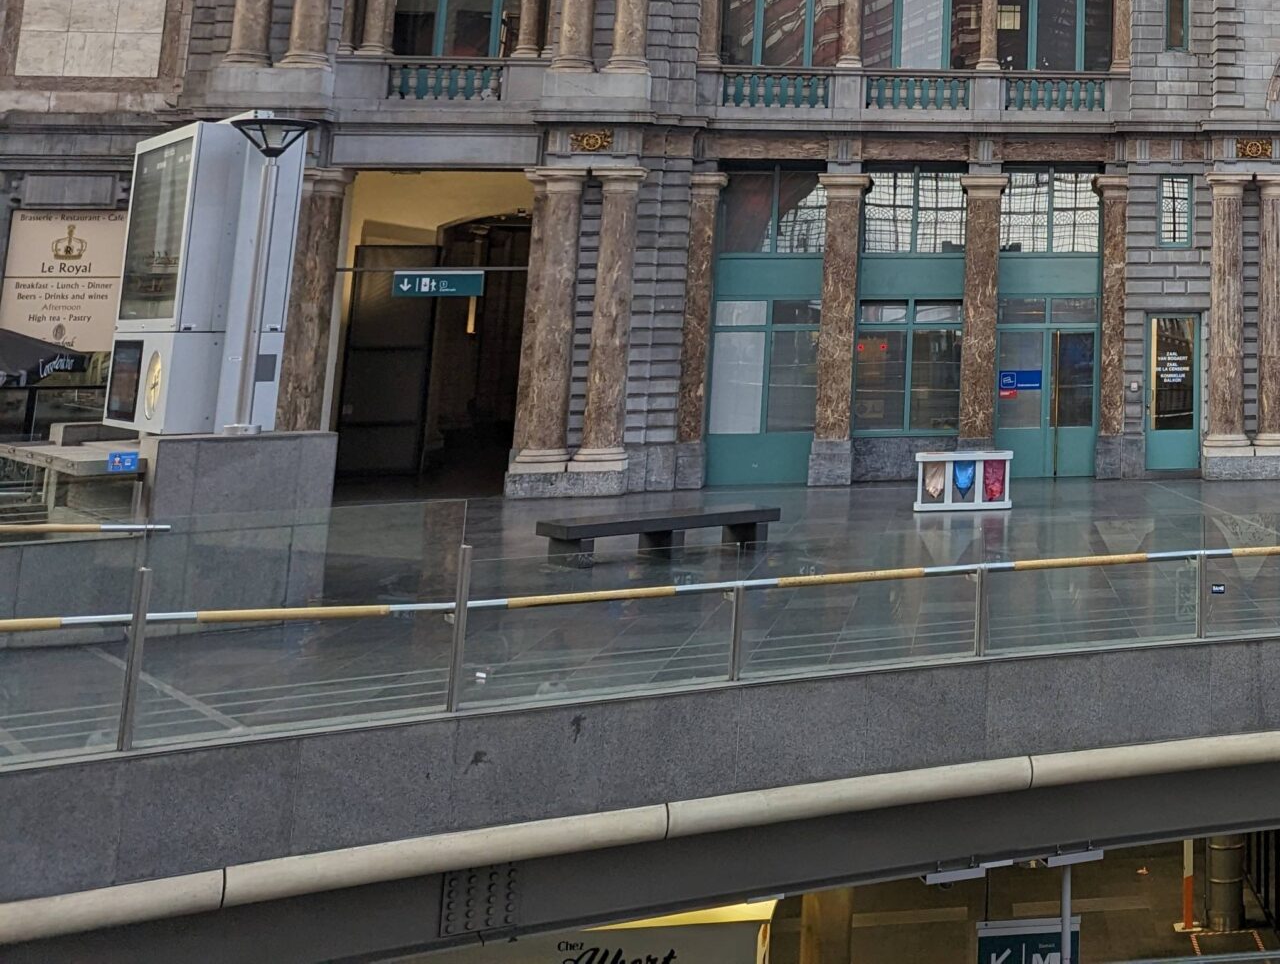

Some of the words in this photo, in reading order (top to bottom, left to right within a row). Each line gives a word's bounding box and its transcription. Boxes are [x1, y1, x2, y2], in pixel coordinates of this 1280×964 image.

[20, 214, 53, 222] Brasserie
[60, 214, 100, 222] Restaurant
[41, 262, 54, 274] Le
[59, 262, 92, 275] Royal
[15, 282, 48, 290] Breakfast
[56, 282, 80, 290] Lunch
[28, 314, 46, 322] High
[68, 314, 92, 322] Pastry
[557, 940, 584, 952] Chez
